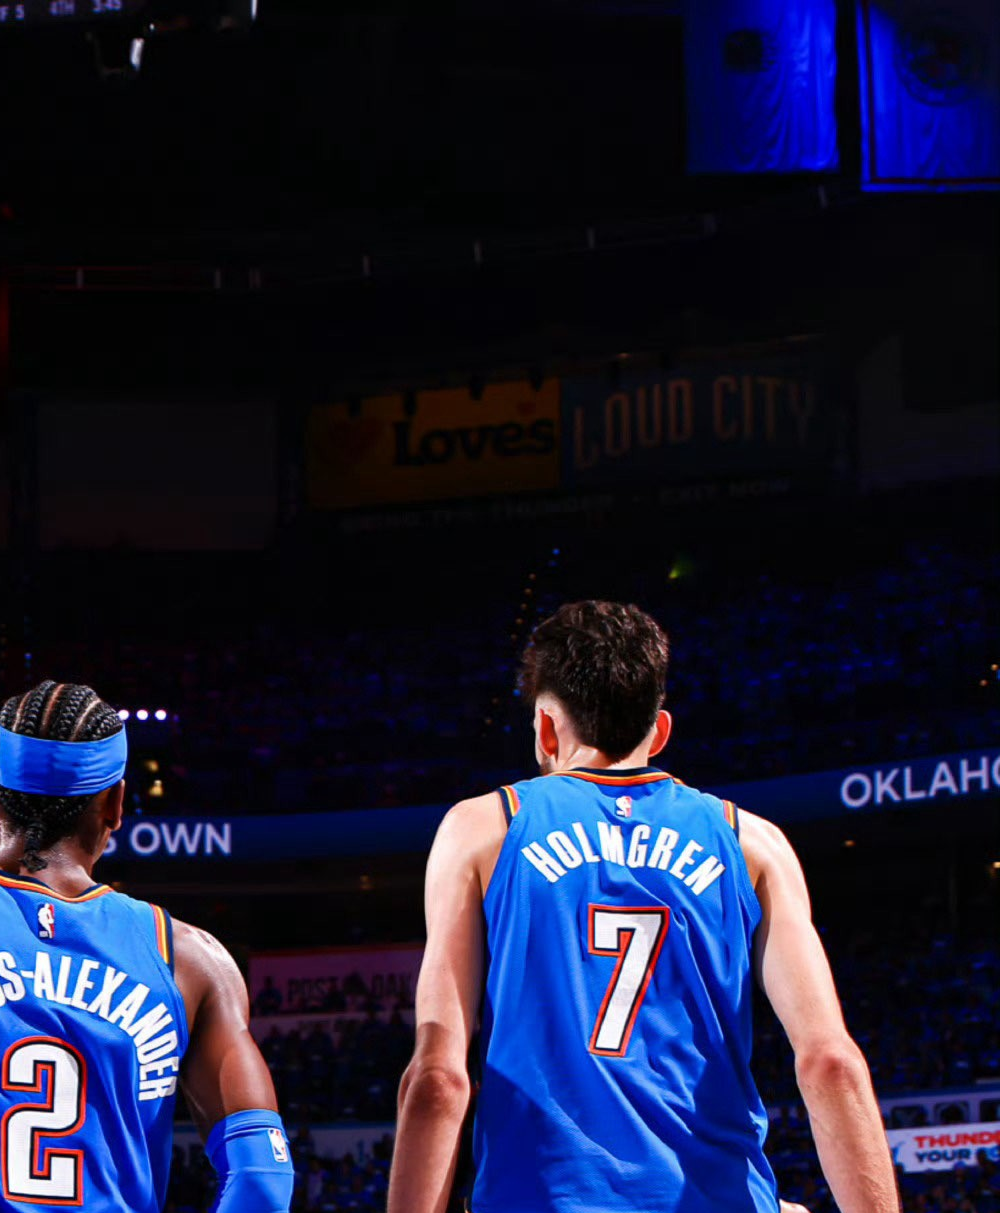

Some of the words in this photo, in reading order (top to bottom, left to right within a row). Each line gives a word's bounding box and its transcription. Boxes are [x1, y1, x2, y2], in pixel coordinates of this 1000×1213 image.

[573, 377, 695, 471] LOUD
[713, 373, 815, 447] CITY
[840, 755, 1000, 809] OKLAH
[129, 821, 232, 855] OWN
[521, 821, 726, 896] HOLMGREN
[588, 904, 670, 1057] 7
[1, 1035, 87, 1206] 2
[915, 1148, 971, 1163] YOUR
